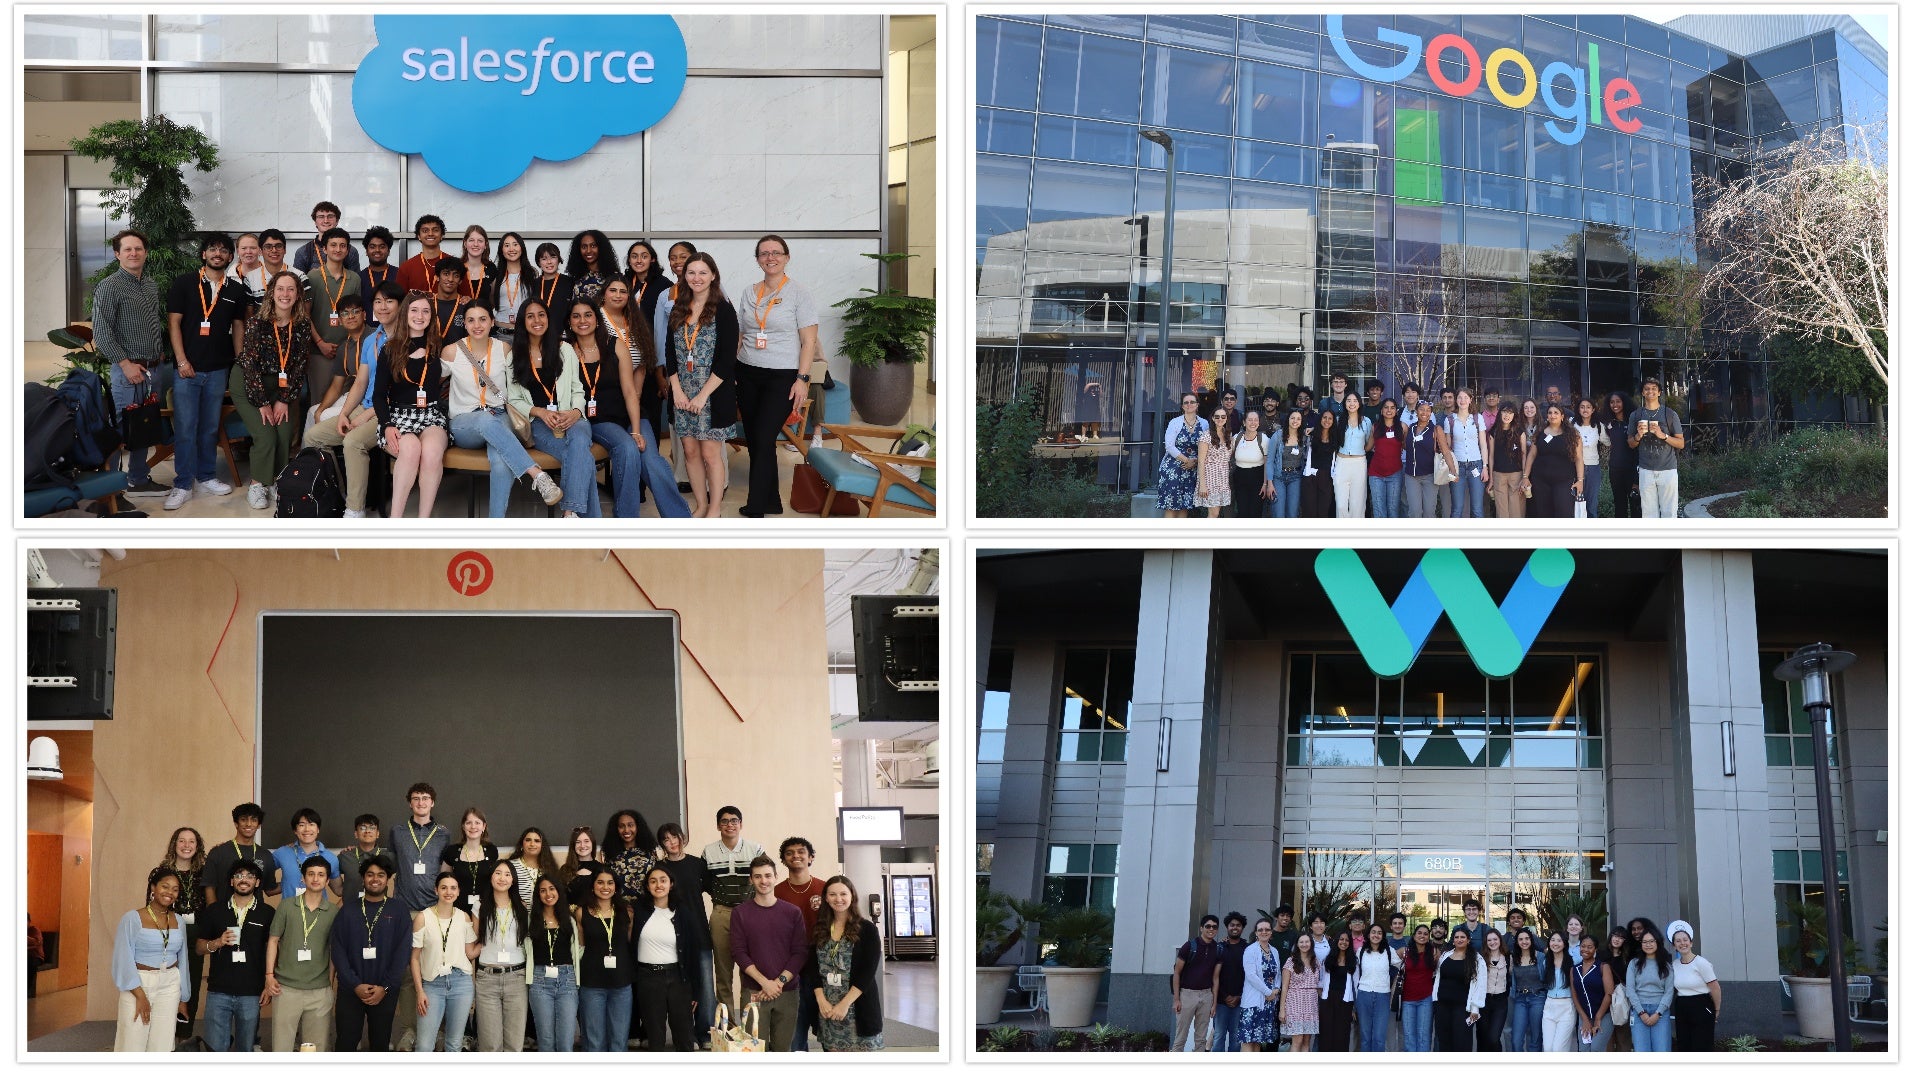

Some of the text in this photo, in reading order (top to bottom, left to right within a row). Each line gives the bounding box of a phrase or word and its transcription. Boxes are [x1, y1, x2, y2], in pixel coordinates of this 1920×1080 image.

[401, 36, 655, 95] salesforce
[1326, 14, 1644, 146] Google
[1424, 857, 1462, 871] 680B
